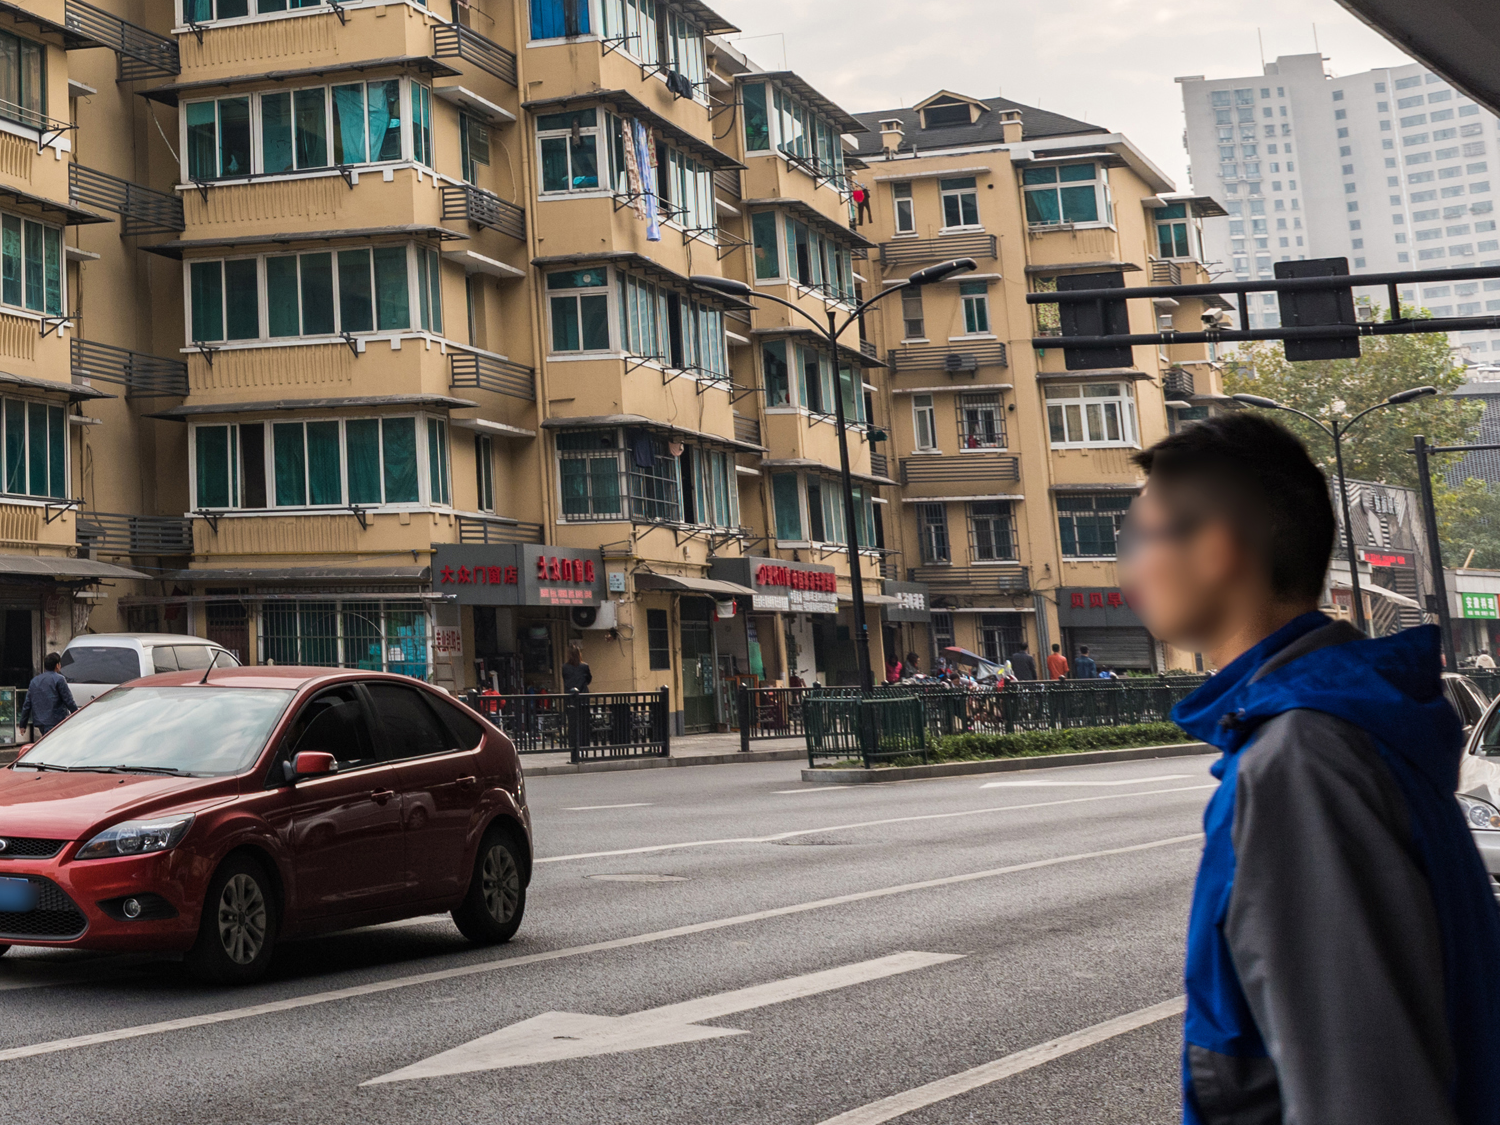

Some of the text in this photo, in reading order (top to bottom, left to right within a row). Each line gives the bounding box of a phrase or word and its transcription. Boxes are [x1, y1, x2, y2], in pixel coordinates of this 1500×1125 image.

[440, 564, 518, 584] 大众门窗店
[537, 555, 595, 583] 大众门窗店
[1071, 592, 1131, 608] 贝贝早
